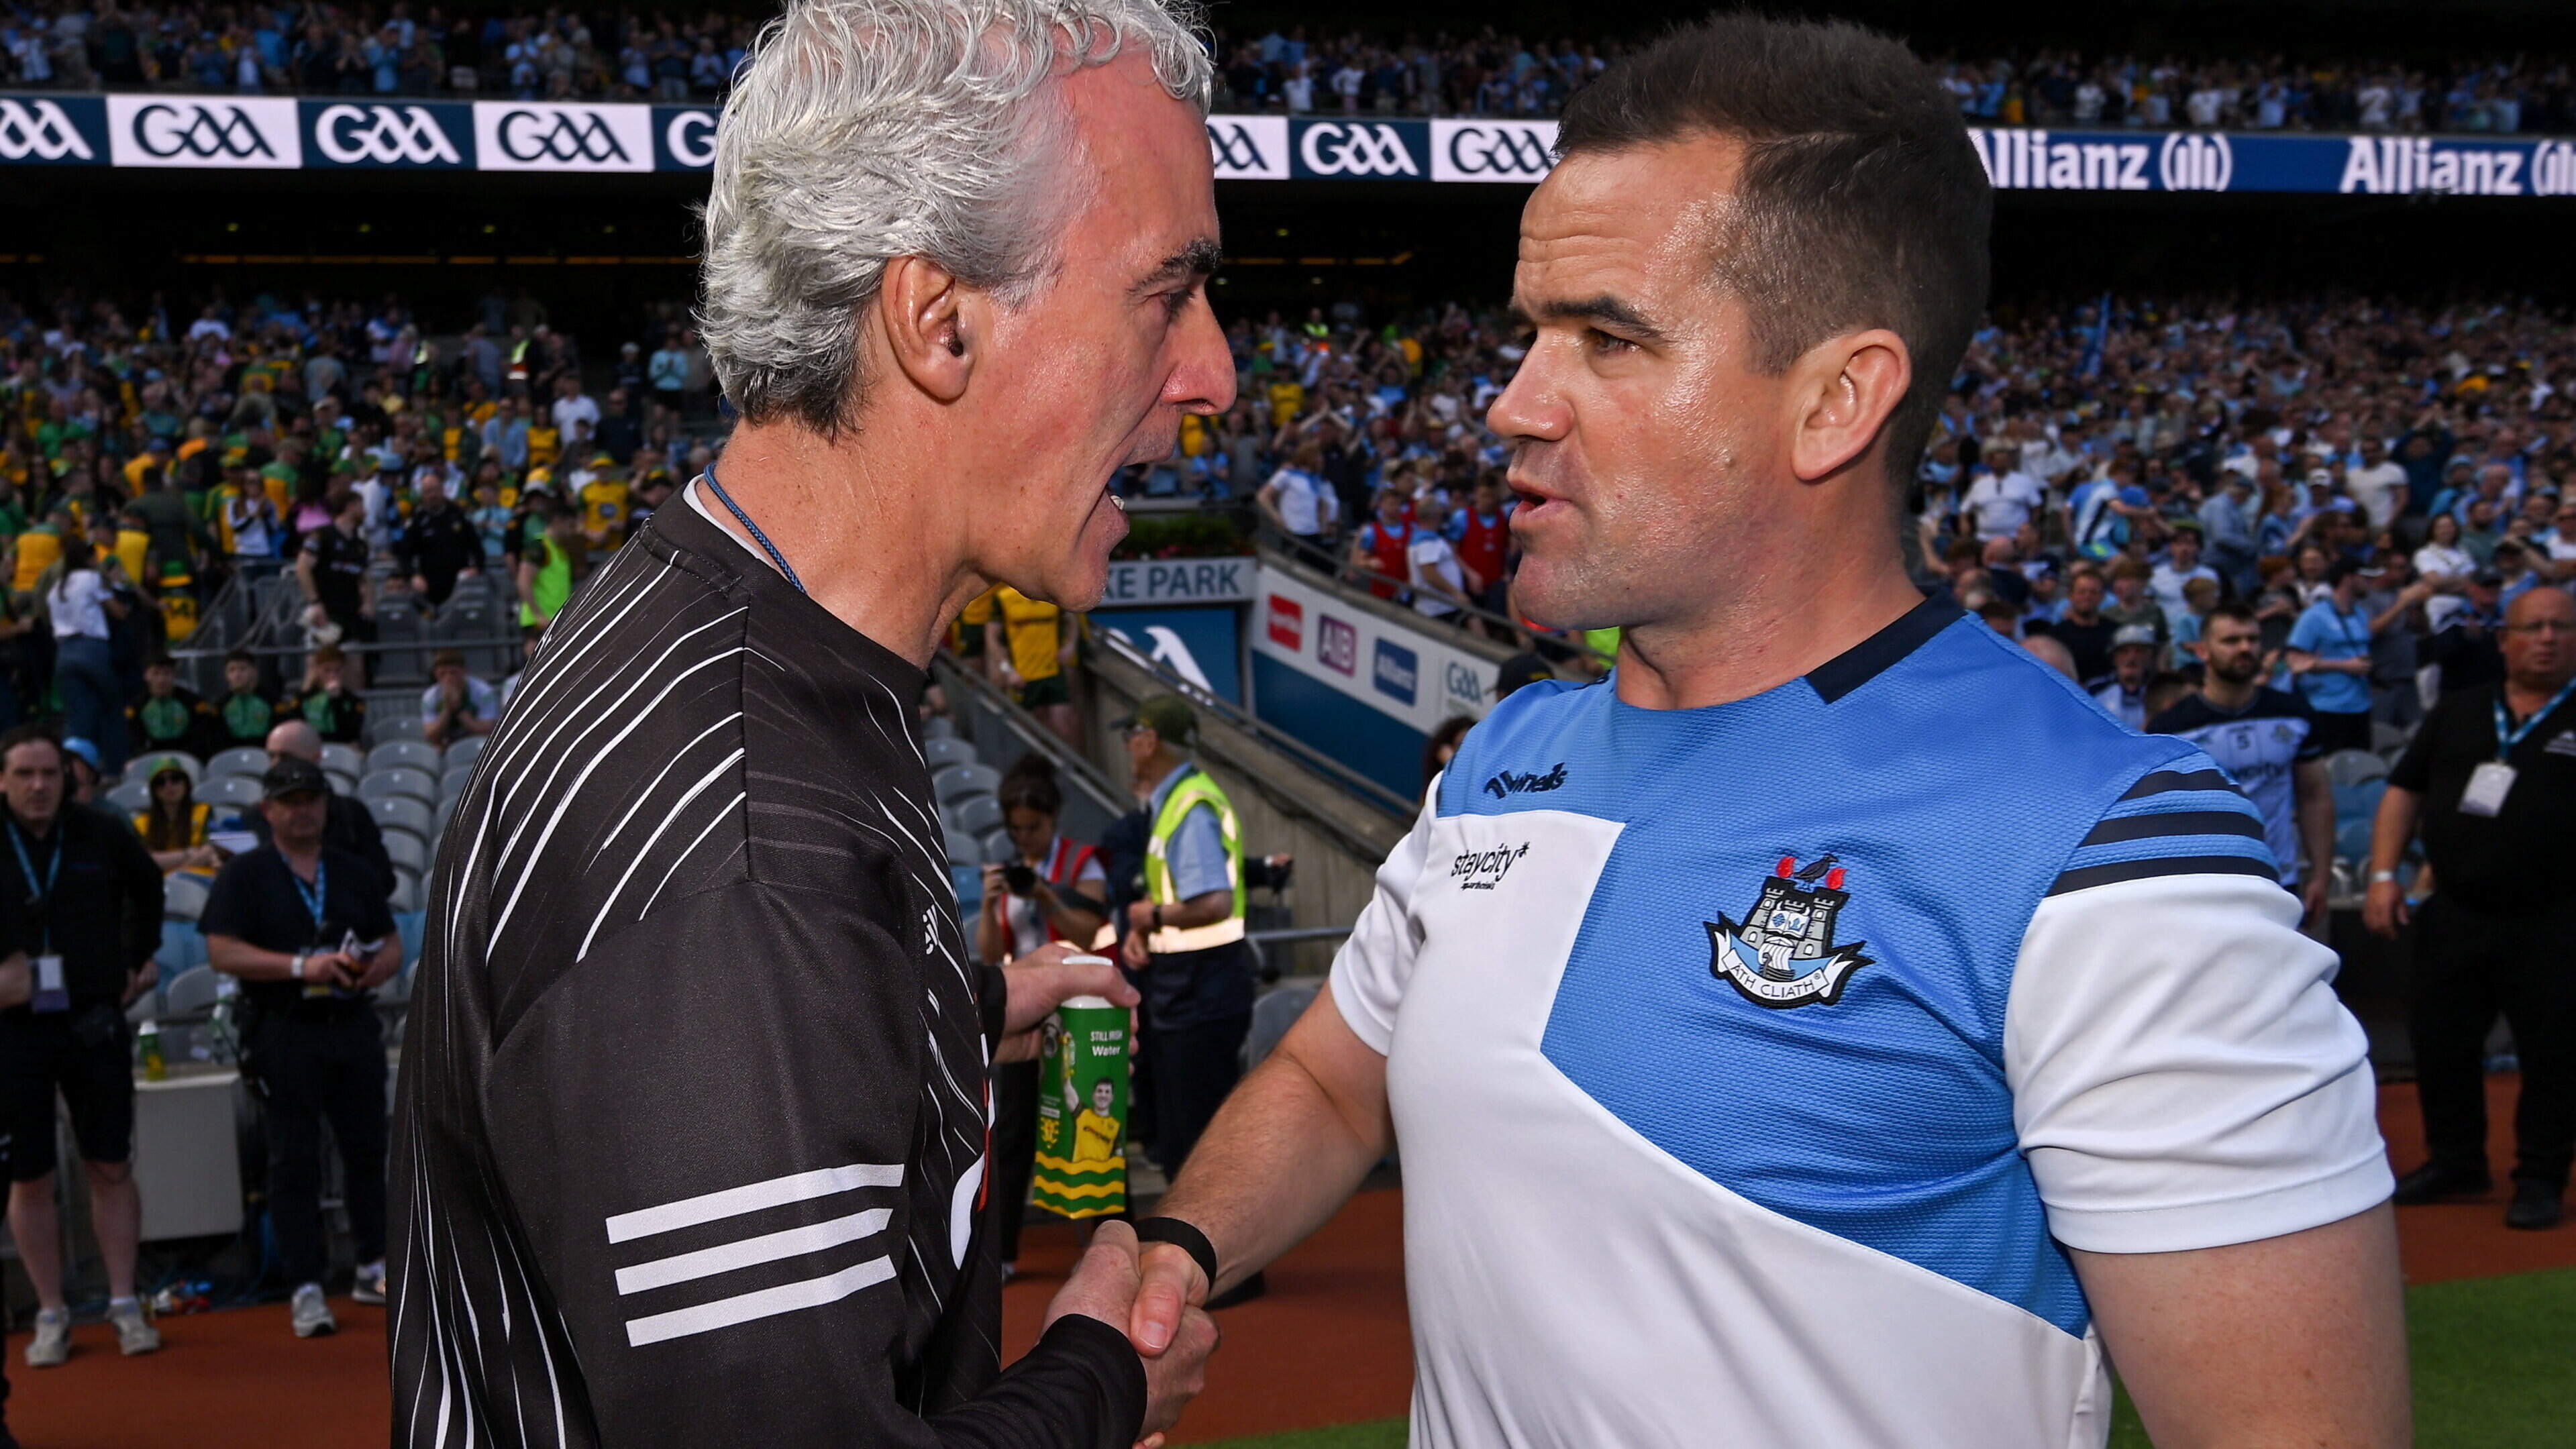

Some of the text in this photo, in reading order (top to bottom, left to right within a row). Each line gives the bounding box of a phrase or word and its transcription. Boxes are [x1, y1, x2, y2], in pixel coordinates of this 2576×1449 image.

[0, 99, 94, 160] AA
[134, 104, 278, 160] GAA
[315, 105, 461, 164] GAA
[497, 111, 632, 163] GAA
[1204, 124, 1270, 170] AA
[1300, 122, 1419, 176] GAA
[2339, 136, 2523, 195] Allianz
[1106, 562, 1240, 598] KE PARK
[1447, 661, 1483, 705] GAA
[1731, 963, 1815, 998] ÁTH CLIATH
[1090, 1030, 1108, 1042] STILL
[1092, 1045, 1121, 1057] Water
